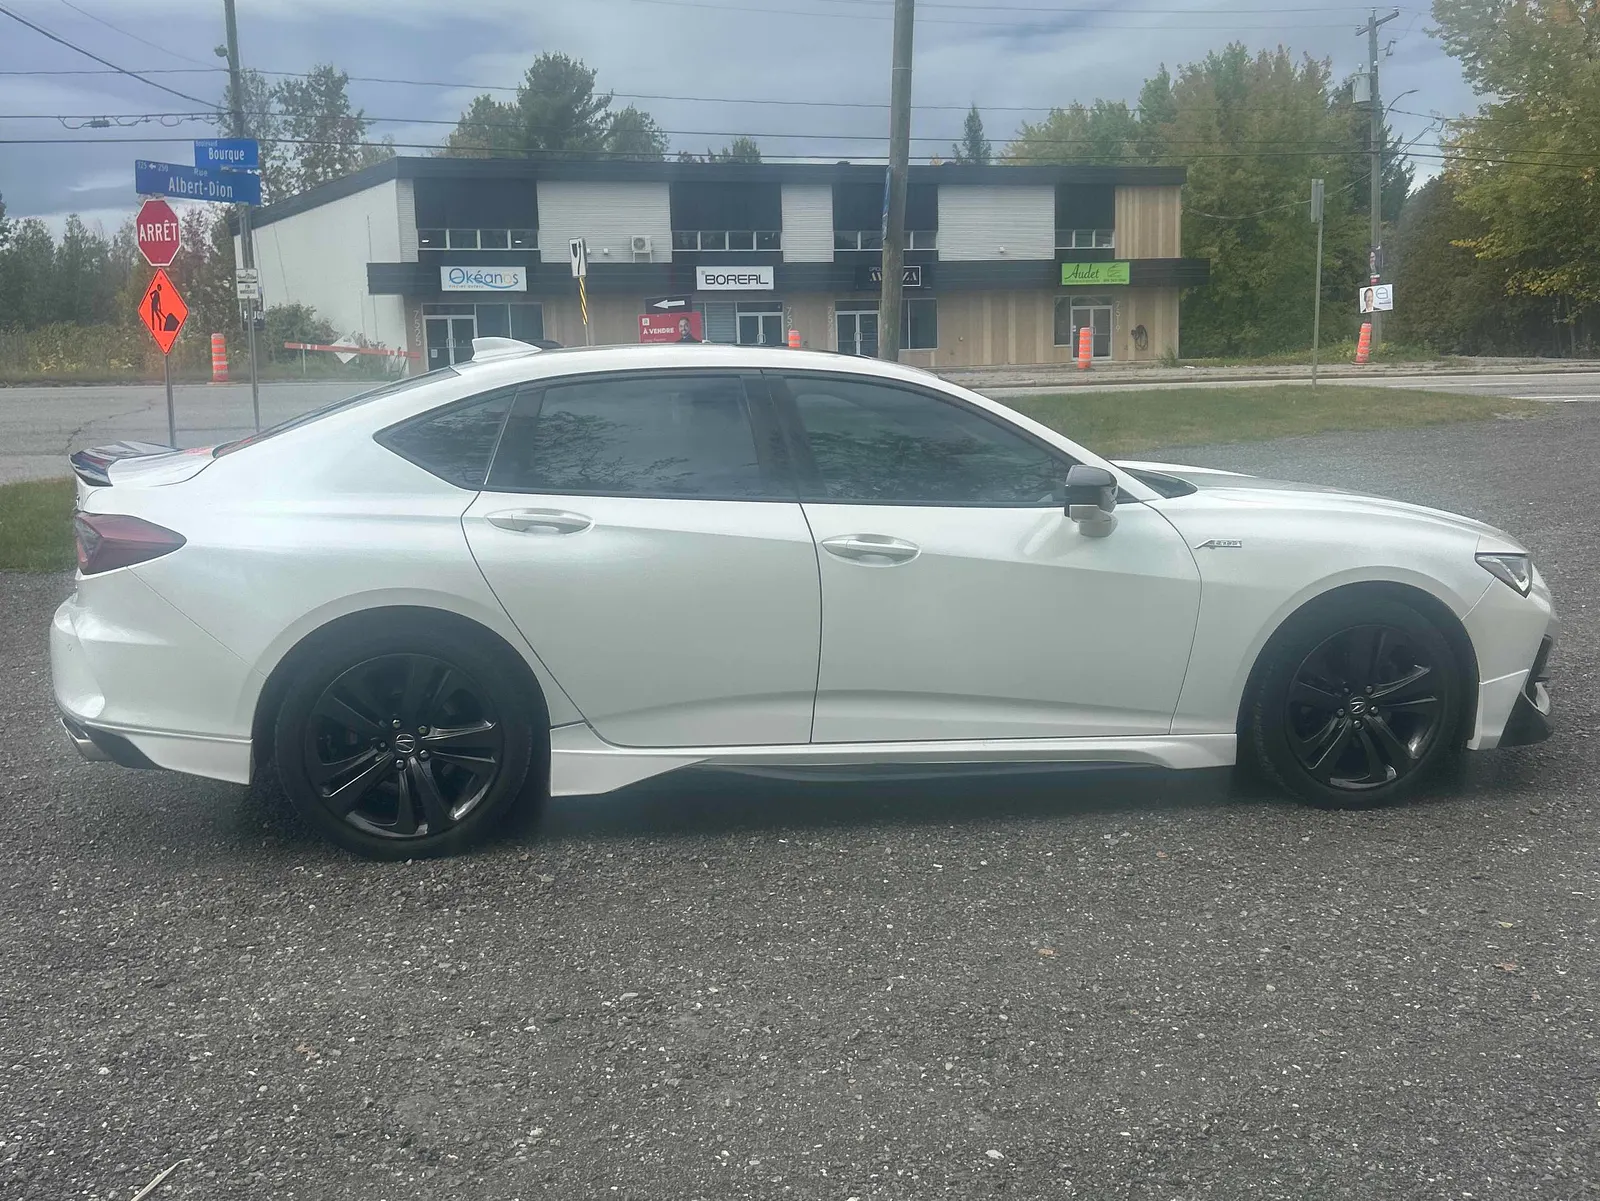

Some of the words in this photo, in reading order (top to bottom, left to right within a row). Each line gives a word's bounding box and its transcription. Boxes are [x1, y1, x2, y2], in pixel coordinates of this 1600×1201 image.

[208, 147, 245, 163] Bourque
[193, 168, 208, 177] Rue
[168, 177, 233, 198] Albert-Dion
[139, 219, 178, 242] ARRÊT
[449, 267, 519, 289] Okéanos
[705, 274, 769, 285] BOREAL
[1064, 263, 1100, 280] Audet
[412, 309, 422, 347] 7525
[785, 306, 793, 332] 752
[643, 327, 649, 335] À
[649, 327, 675, 335] VENDRE
